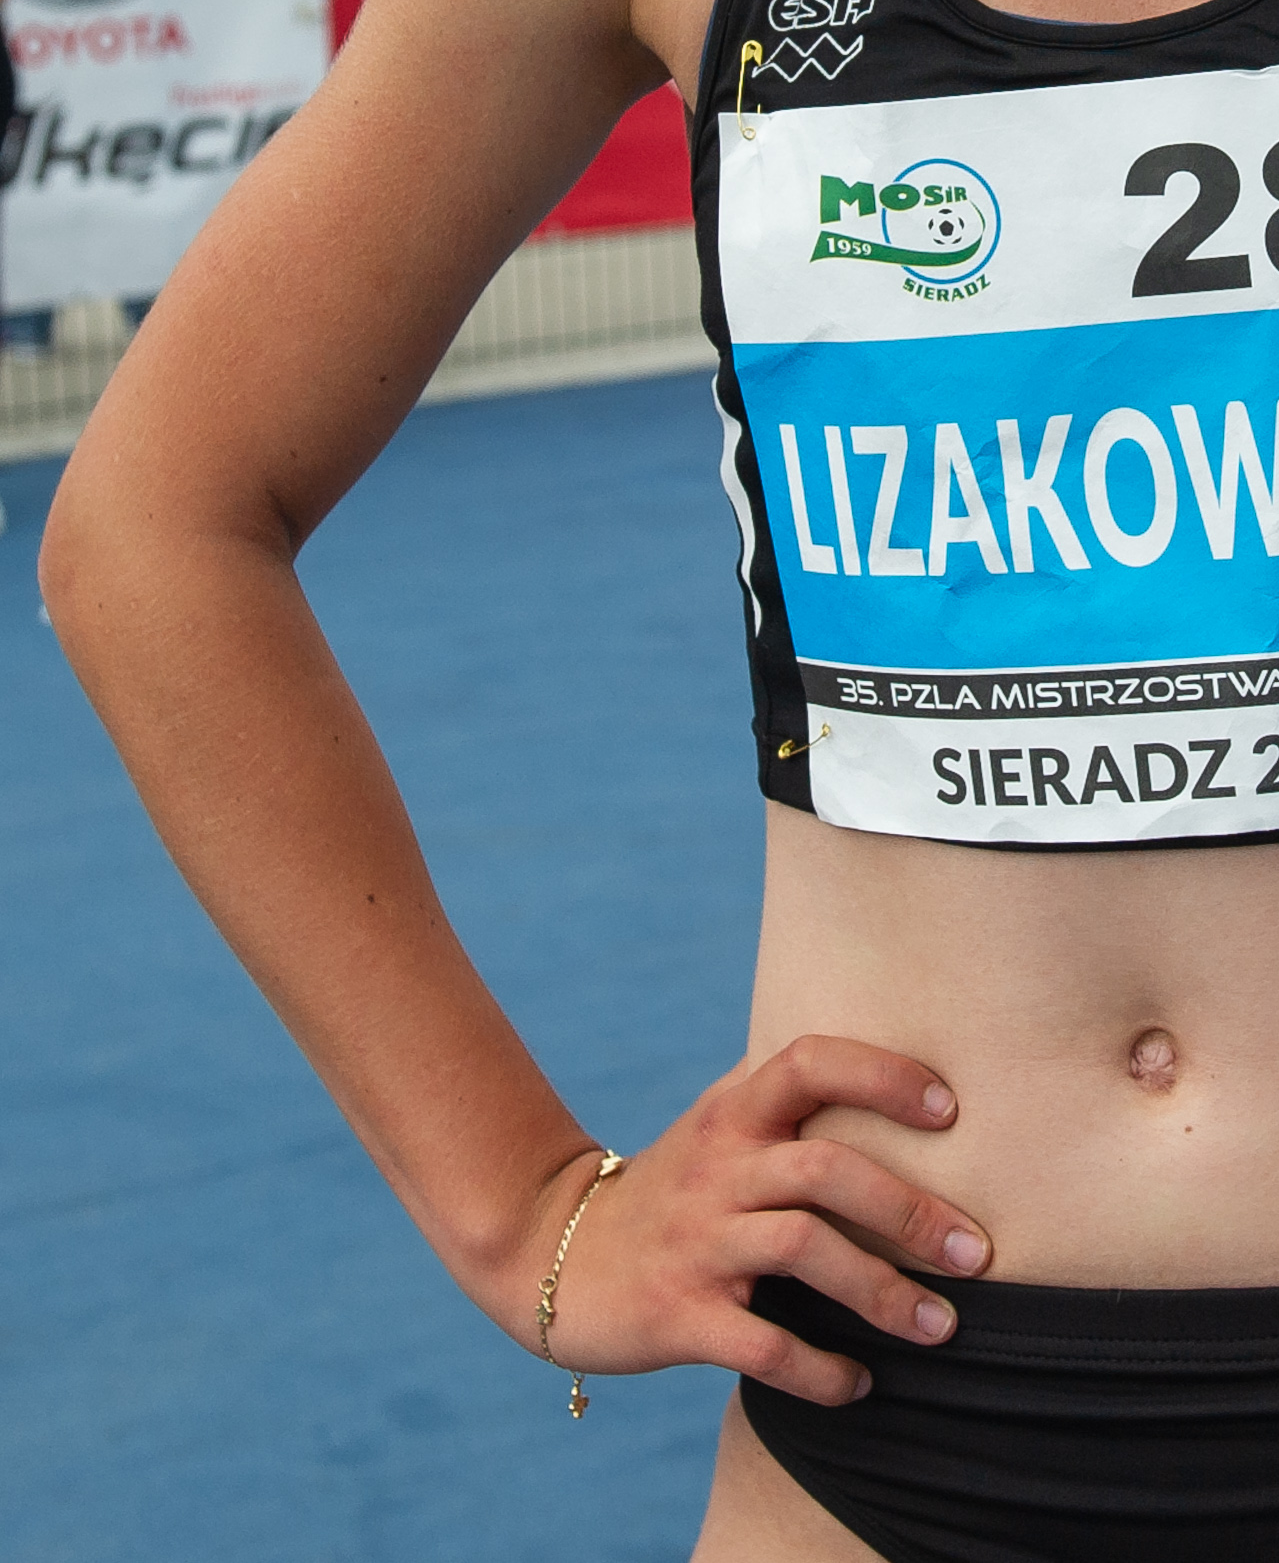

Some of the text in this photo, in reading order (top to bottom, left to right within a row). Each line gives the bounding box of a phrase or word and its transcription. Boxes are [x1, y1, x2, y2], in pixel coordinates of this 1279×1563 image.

[8, 14, 190, 68] OYOTA
[826, 237, 872, 256] 1959
[902, 274, 992, 302] SIERADZ
[836, 677, 884, 705] 35.
[891, 683, 982, 711] PZLA
[934, 738, 1237, 807] SIERADZ
